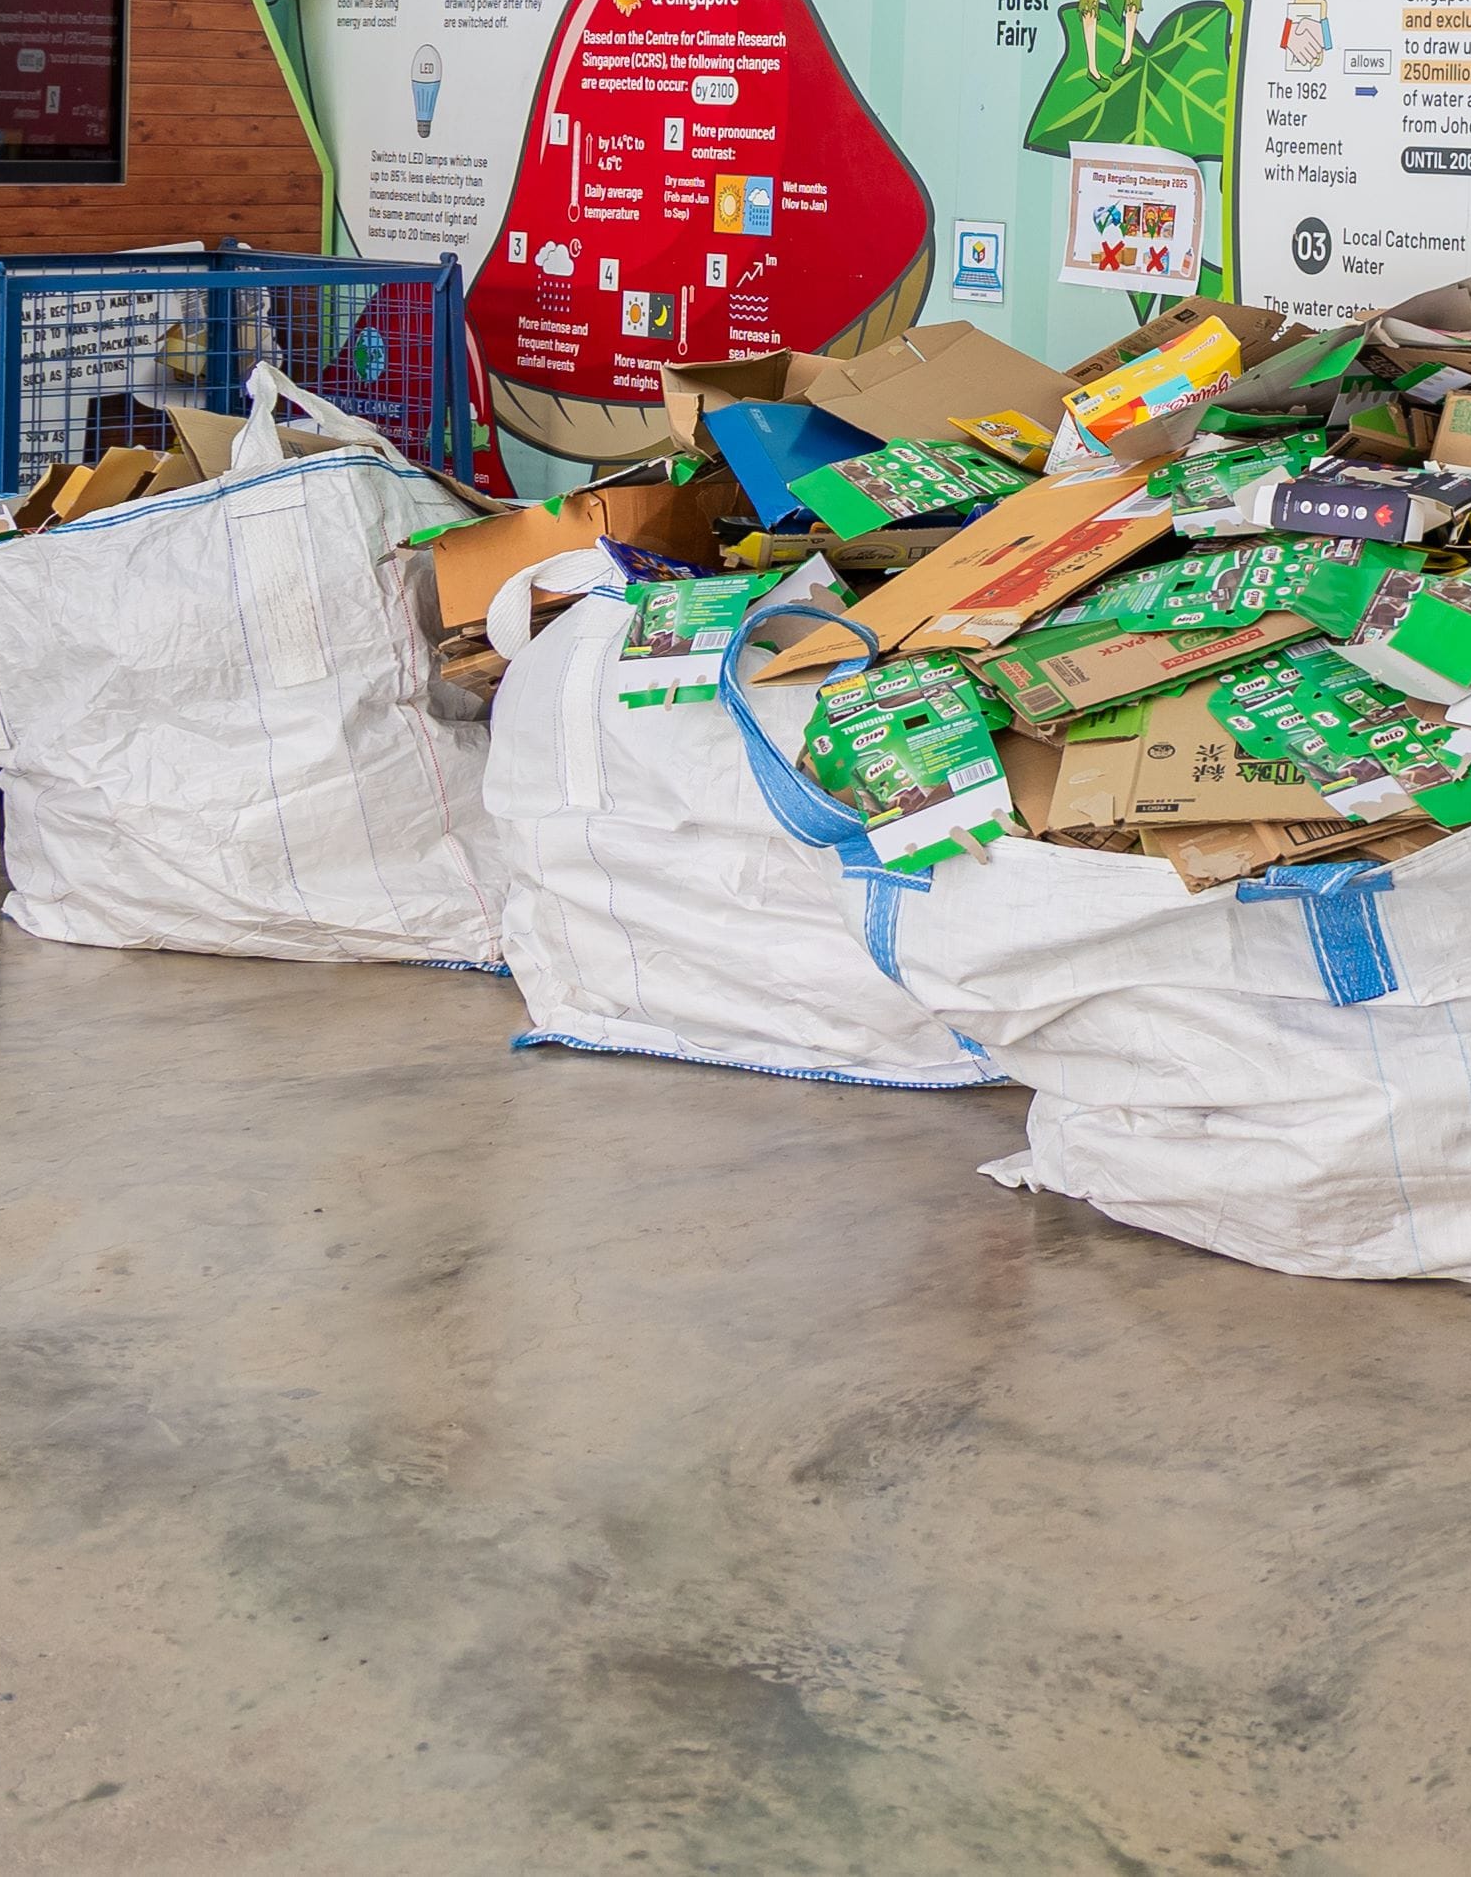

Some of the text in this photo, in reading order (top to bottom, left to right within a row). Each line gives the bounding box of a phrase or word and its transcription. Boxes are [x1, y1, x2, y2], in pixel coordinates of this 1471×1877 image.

[582, 29, 786, 47] Based on the Centre for Climate Research
[997, 23, 1037, 49] Fairy
[695, 81, 735, 102] by 2100
[1405, 150, 1445, 171] UNTIL
